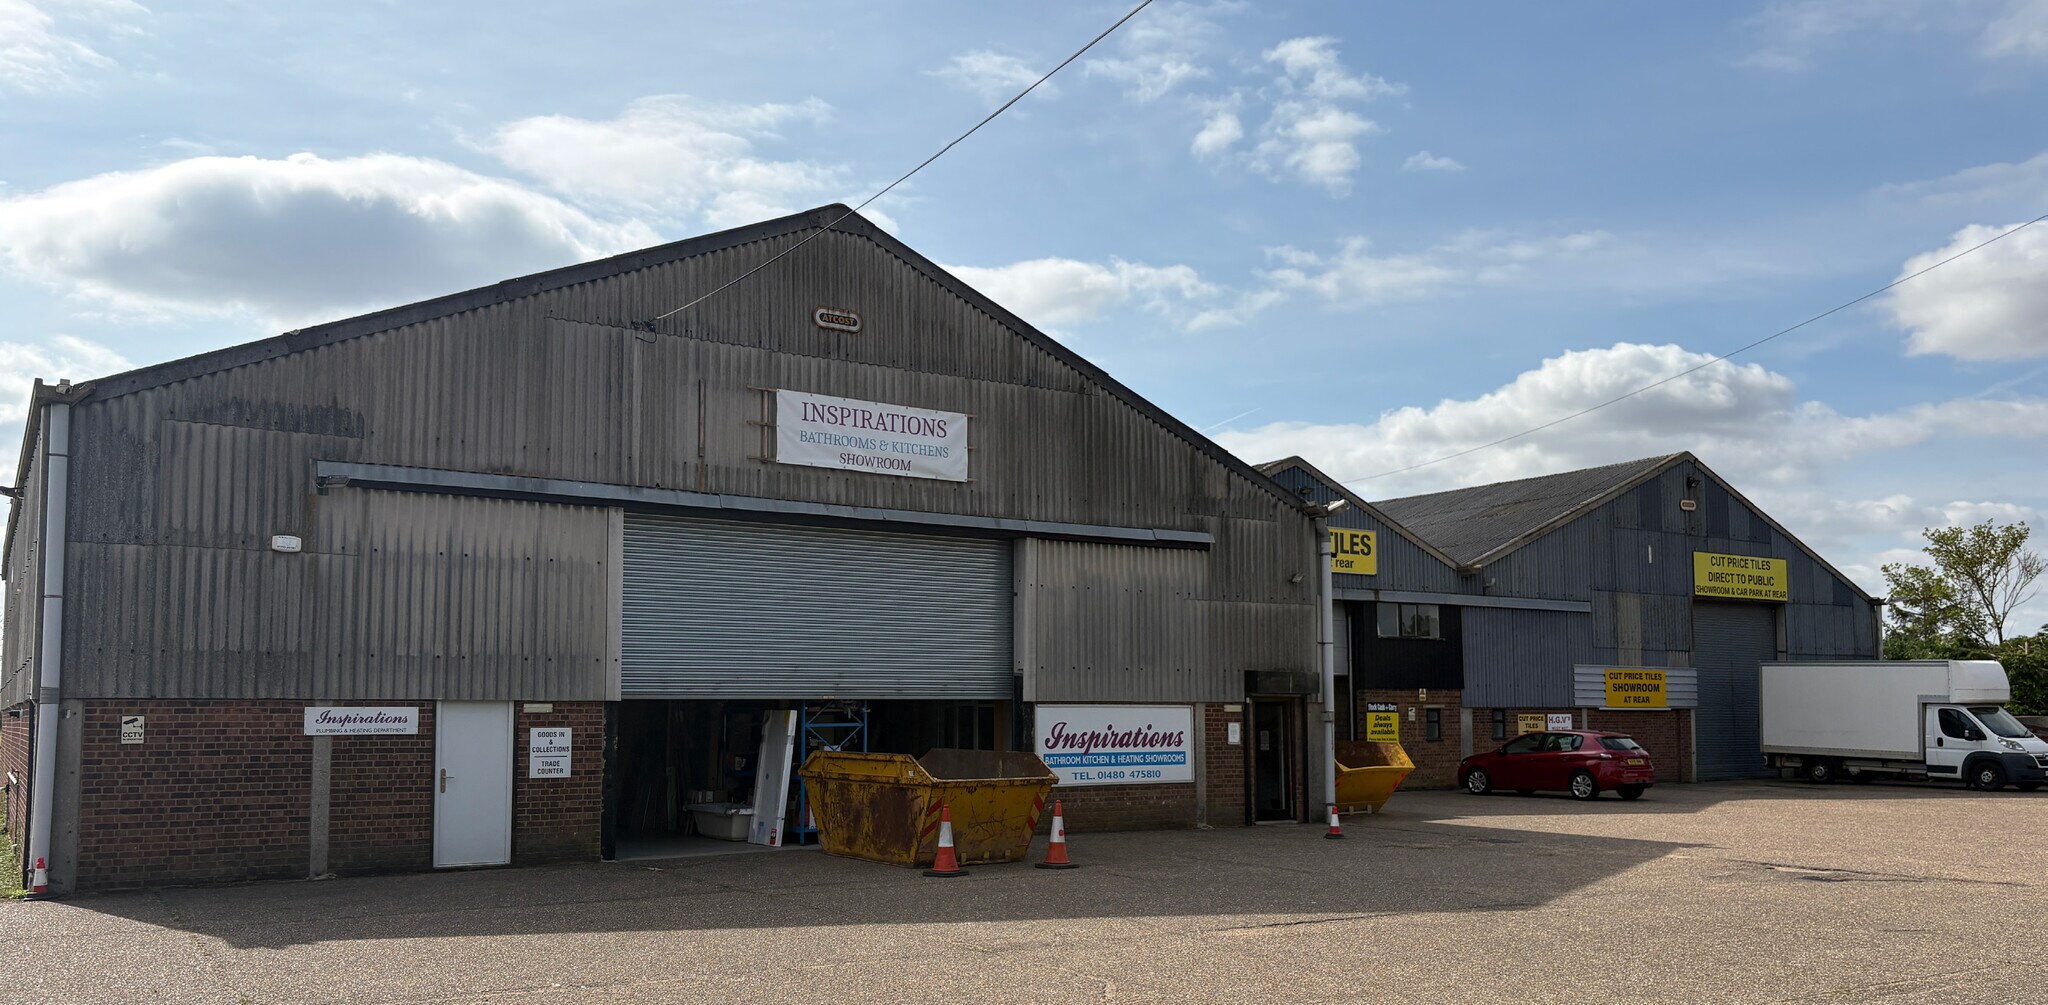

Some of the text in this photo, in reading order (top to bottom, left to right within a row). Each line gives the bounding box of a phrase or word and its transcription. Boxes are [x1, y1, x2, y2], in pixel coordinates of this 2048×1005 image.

[822, 313, 855, 326] ATCOST
[801, 401, 947, 438] INSPIRATIONS
[800, 430, 949, 459] BATHROOMS & KITCHENS
[838, 452, 912, 472] SHOWROOM
[1330, 532, 1371, 556] ILES
[1335, 559, 1354, 568] rear
[1710, 556, 1771, 571] CUT PRICE TILES
[1708, 571, 1774, 586] DIRECT TO PUBLIC
[1696, 585, 1730, 595] SHOWROOM
[1736, 588, 1748, 596] CAR
[1748, 588, 1764, 597] PARK
[1764, 590, 1772, 598] AT
[1772, 590, 1787, 599] REAR
[1609, 672, 1663, 681] CUT PRICE TILES
[1612, 683, 1660, 692] SHOWROOM
[315, 710, 408, 727] Inspirations
[1044, 721, 1184, 756] Inspirations
[1045, 753, 1185, 765] BATHROOM KITCHEN & HEATING SHOWROOMS
[1071, 770, 1161, 780] TEL. 01480 475810
